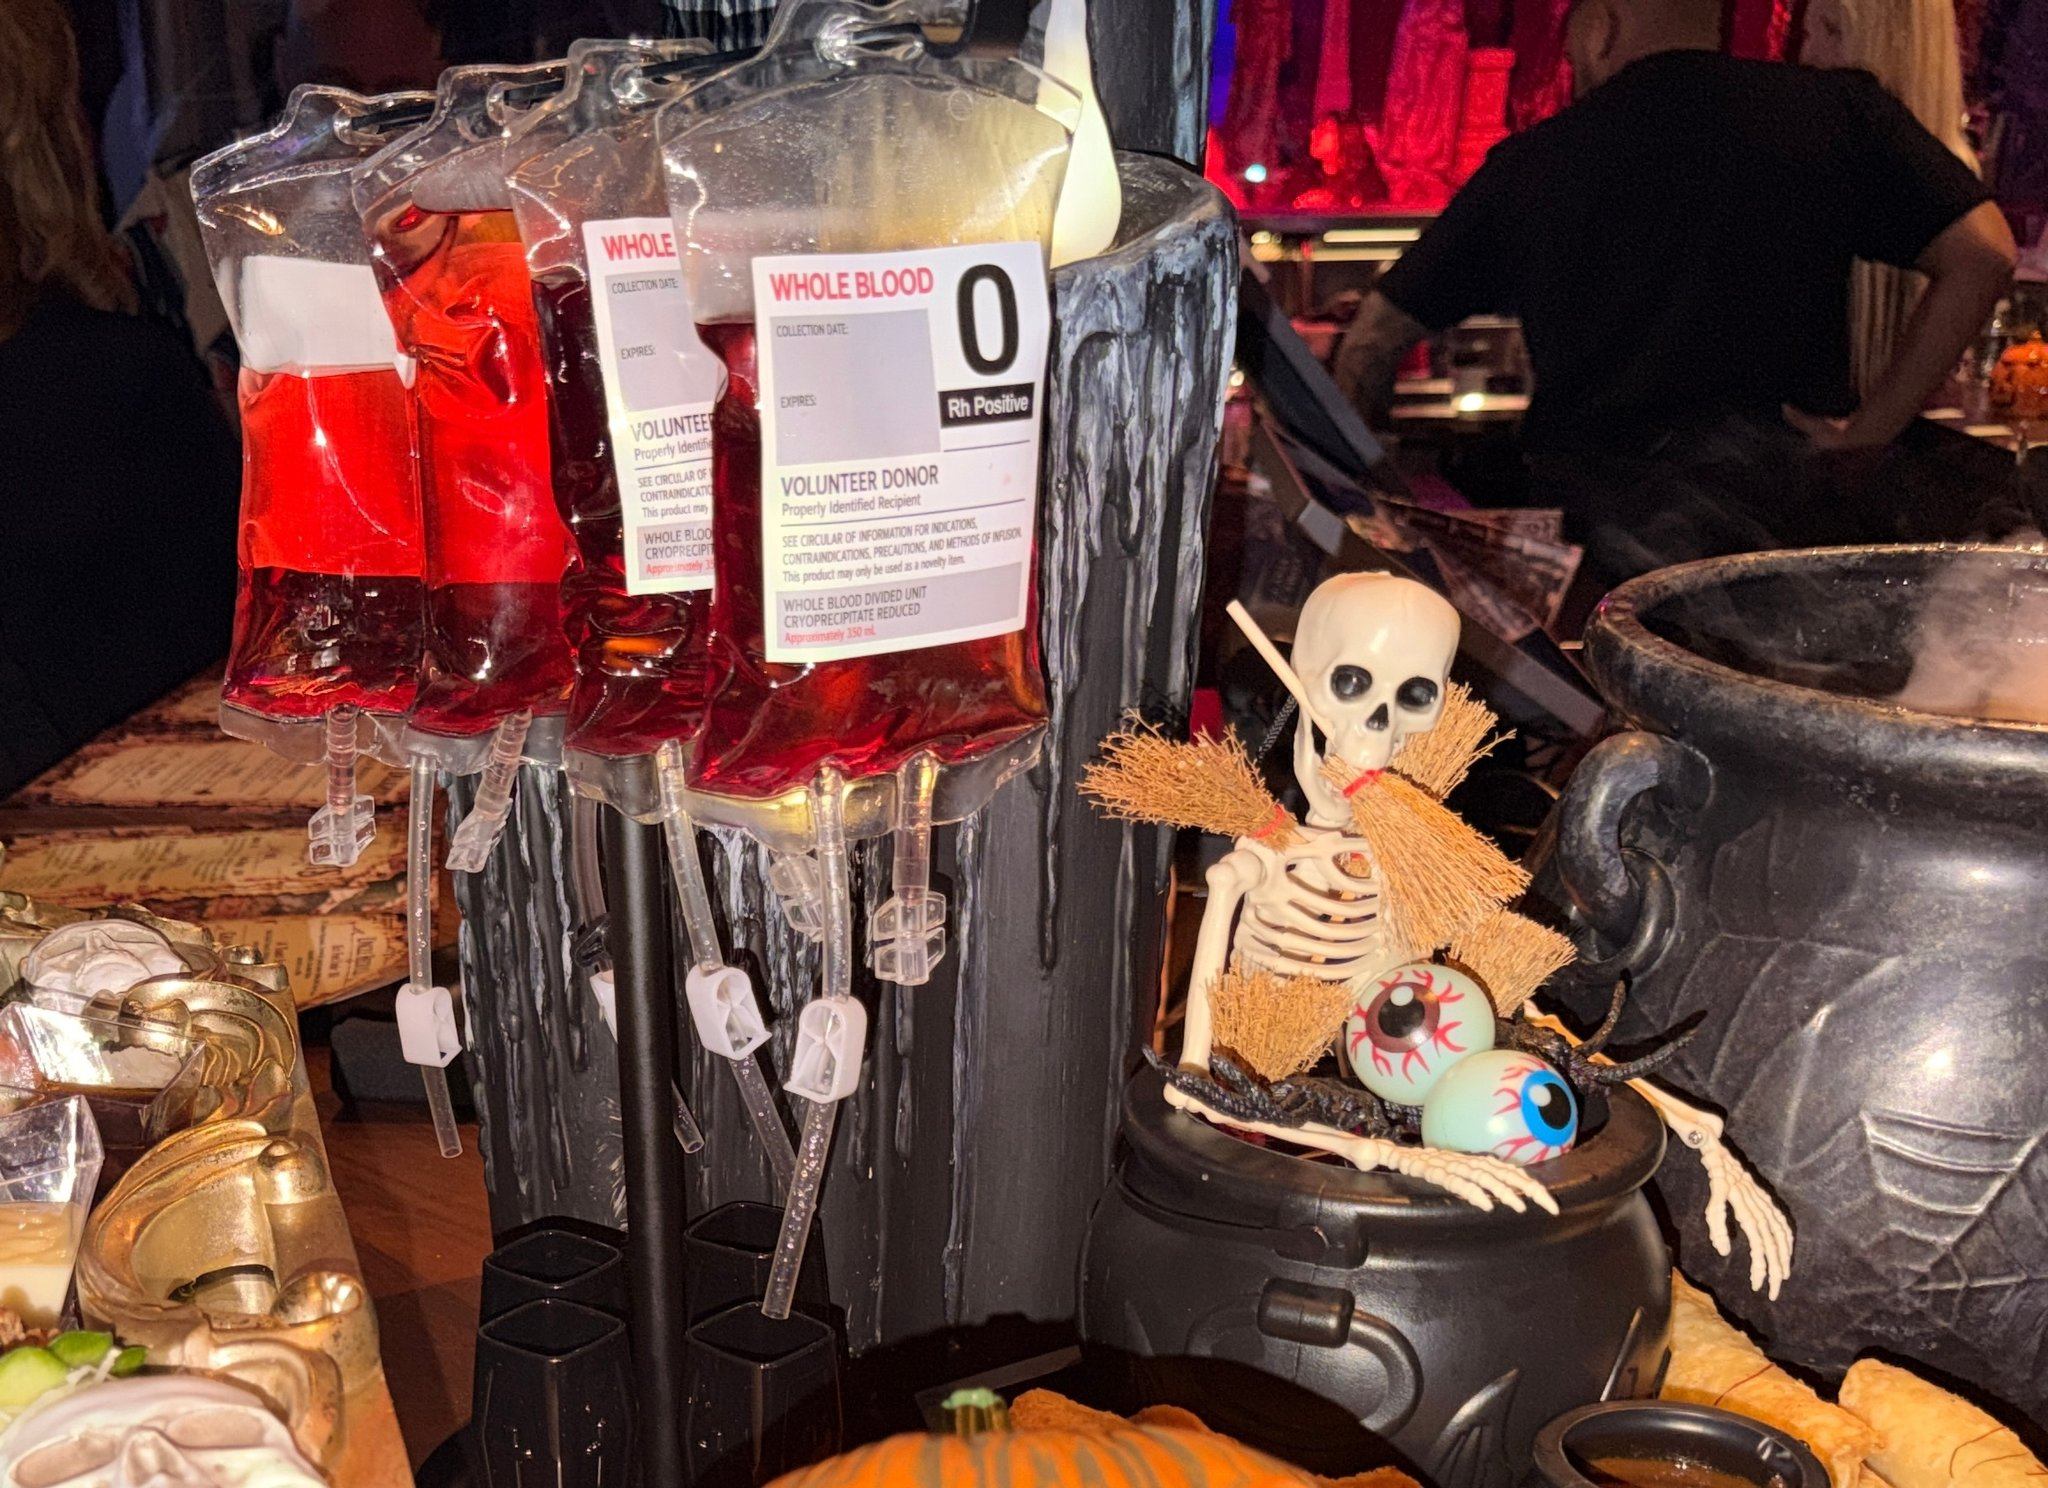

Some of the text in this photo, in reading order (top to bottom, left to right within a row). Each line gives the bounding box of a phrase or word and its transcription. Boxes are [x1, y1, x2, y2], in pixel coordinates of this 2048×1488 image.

[602, 233, 676, 261] WHOLE
[612, 279, 658, 294] COLLECTION
[770, 267, 934, 301] WHOLE BLOOD
[776, 323, 825, 338] COLLECTION
[621, 345, 657, 360] EXPIRES:
[780, 394, 817, 409] EXPIRES:
[948, 393, 1029, 419] Rh Positive
[634, 444, 675, 461] Properly
[638, 468, 707, 488] SEE CIRCULAR OF
[781, 465, 939, 497] VOLUNTEER DONOR
[642, 504, 708, 519] This product may
[782, 494, 921, 519] Properly Identified Recipient
[644, 528, 713, 544] WHOLE BLOO
[783, 535, 798, 548] SEE
[801, 532, 843, 547] CIRCULAR
[845, 531, 856, 544] OF
[859, 526, 913, 542] INFORMATION
[915, 523, 930, 536] FOR
[929, 539, 945, 552] AND
[946, 533, 980, 549] METHODS
[981, 532, 991, 544] OF
[645, 543, 715, 560] CRYOPRECIPIT
[783, 571, 800, 583] This
[803, 569, 835, 585] product
[838, 570, 854, 582] may
[855, 565, 872, 580] only
[874, 563, 883, 575] be
[885, 561, 903, 574] used
[904, 562, 912, 571] as
[921, 556, 946, 569] novelty
[784, 585, 927, 612] WHOLE BLOOD DIVIDED UNIT
[784, 603, 921, 628] CRYOPRECIPITATE REDUCED
